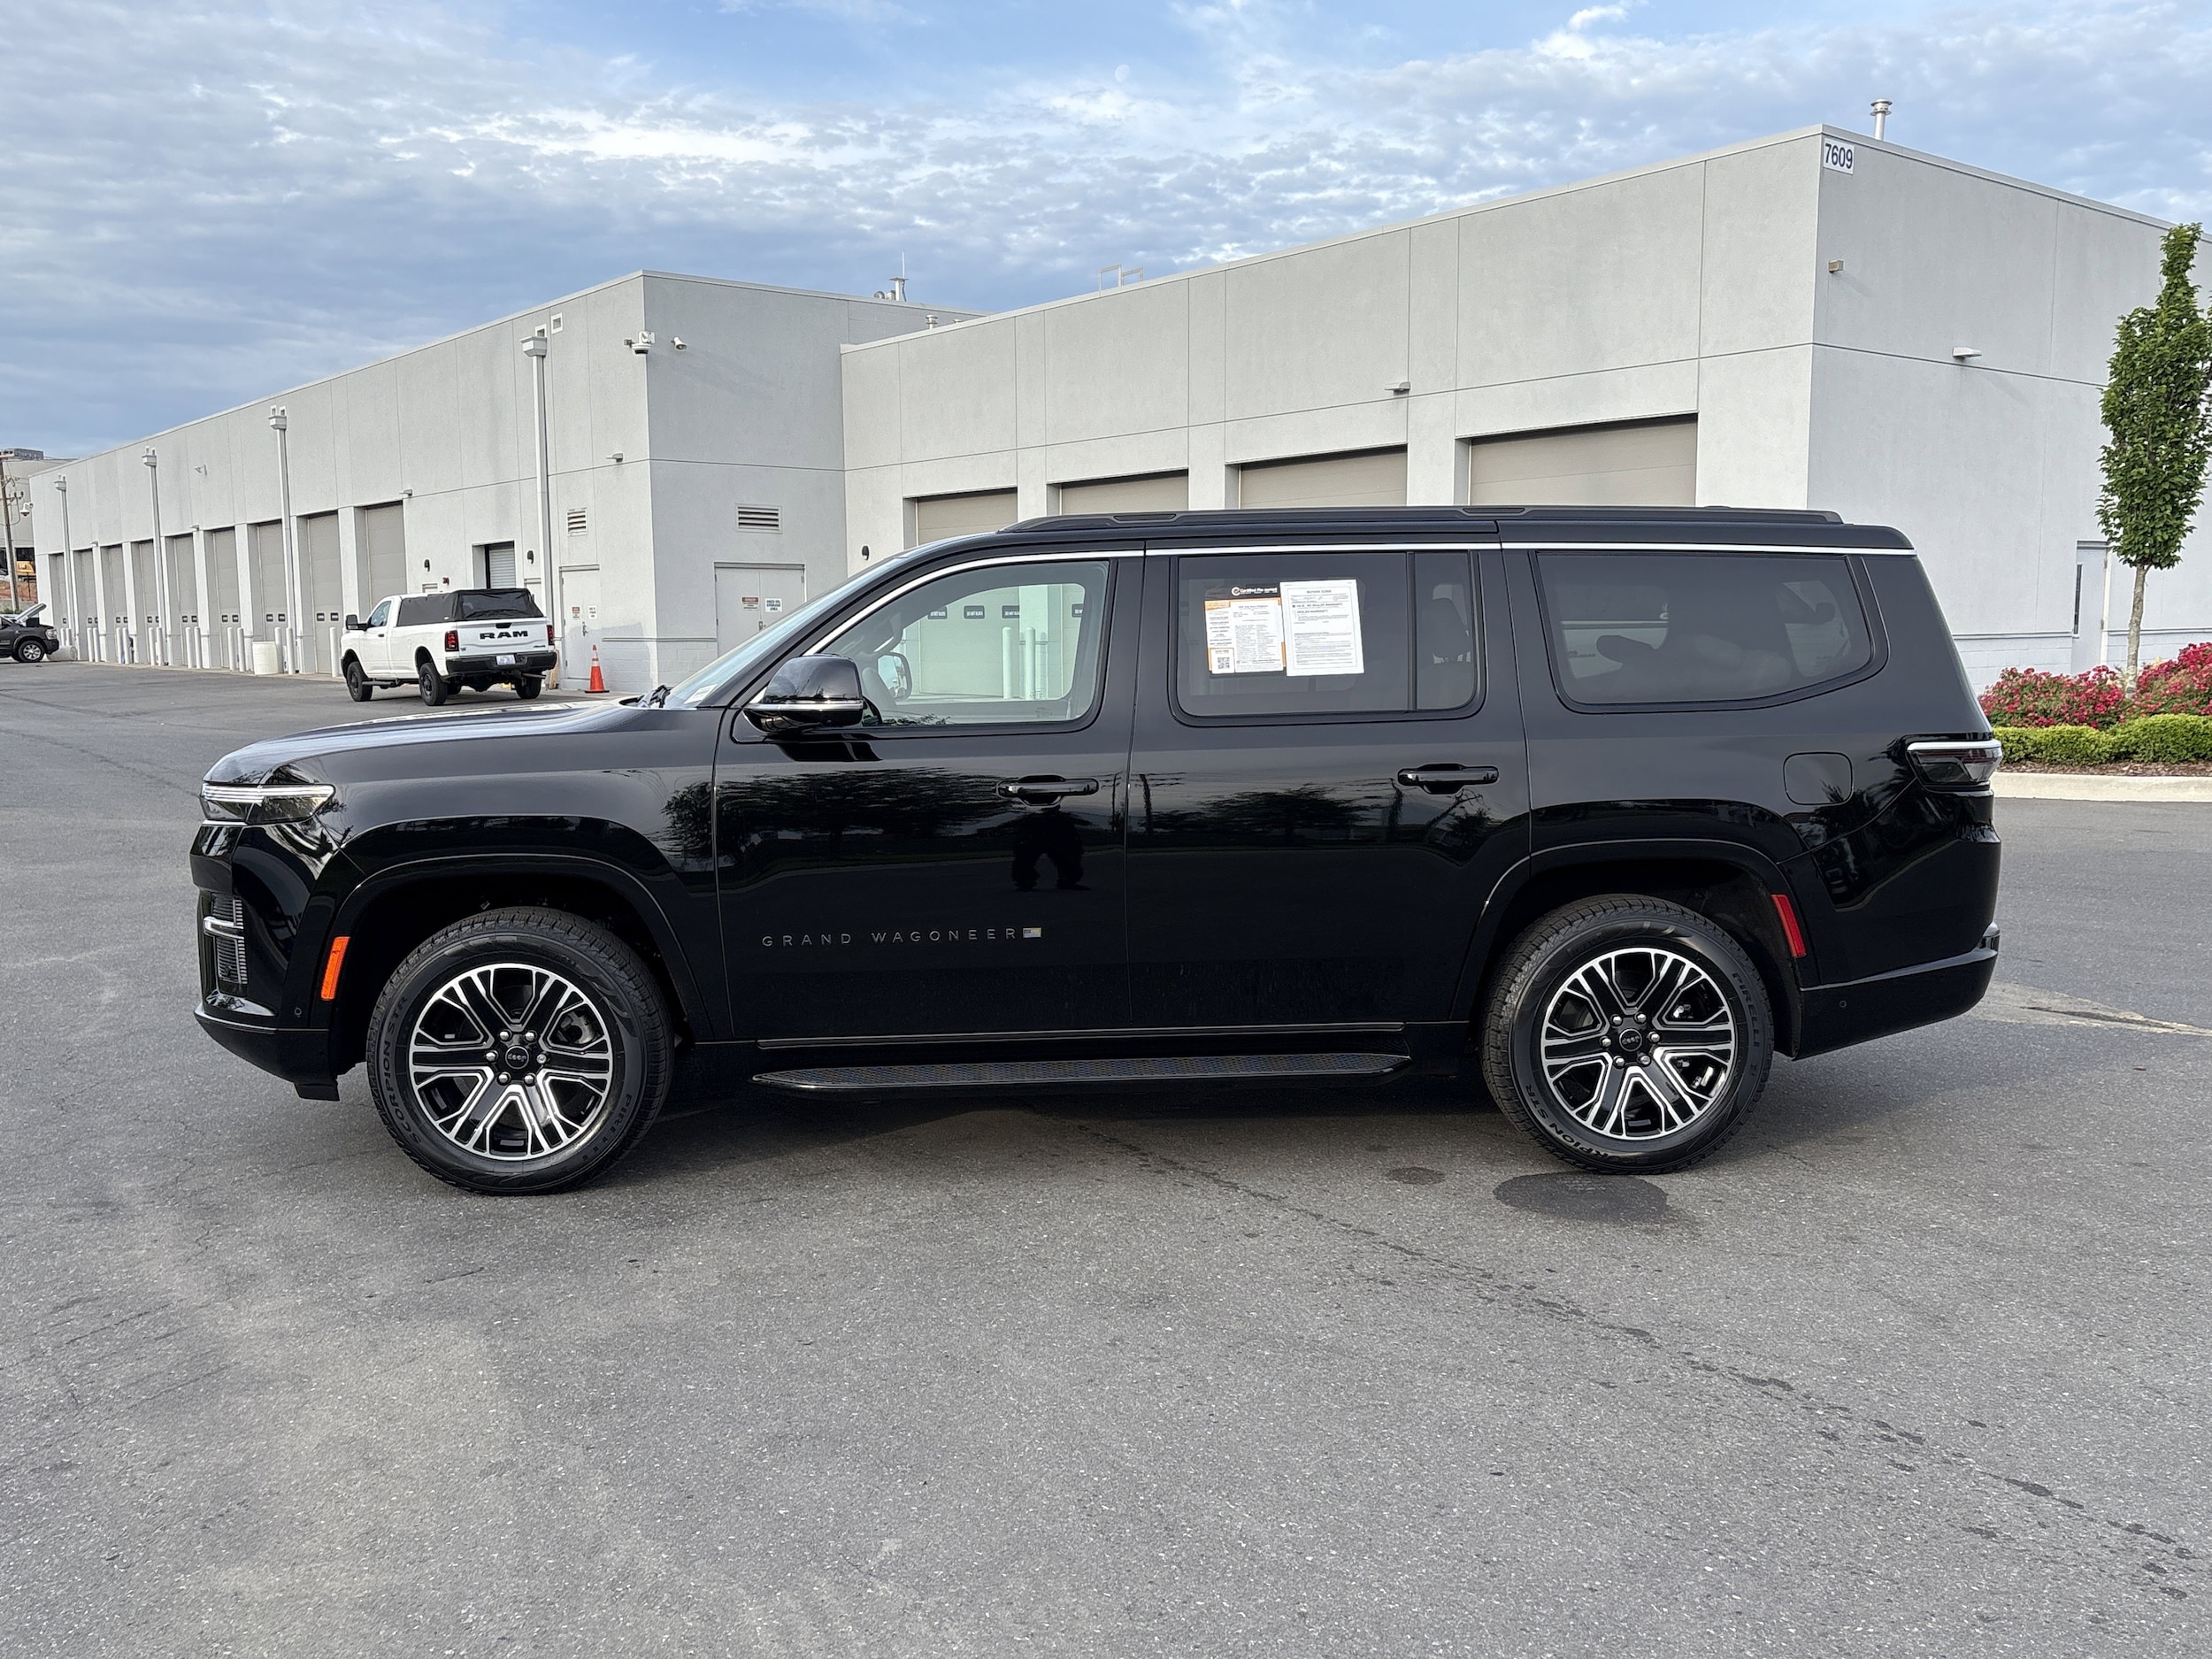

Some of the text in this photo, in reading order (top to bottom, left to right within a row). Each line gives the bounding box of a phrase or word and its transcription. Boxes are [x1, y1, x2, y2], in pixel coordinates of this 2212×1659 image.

[1824, 142, 1853, 169] 7609
[480, 631, 528, 640] RAM
[762, 927, 1016, 947] GRAND WAGONEER
[1732, 972, 1759, 1048] PIRELLI
[383, 995, 422, 1144] SCORPION STR
[1525, 1084, 1548, 1119] STR
